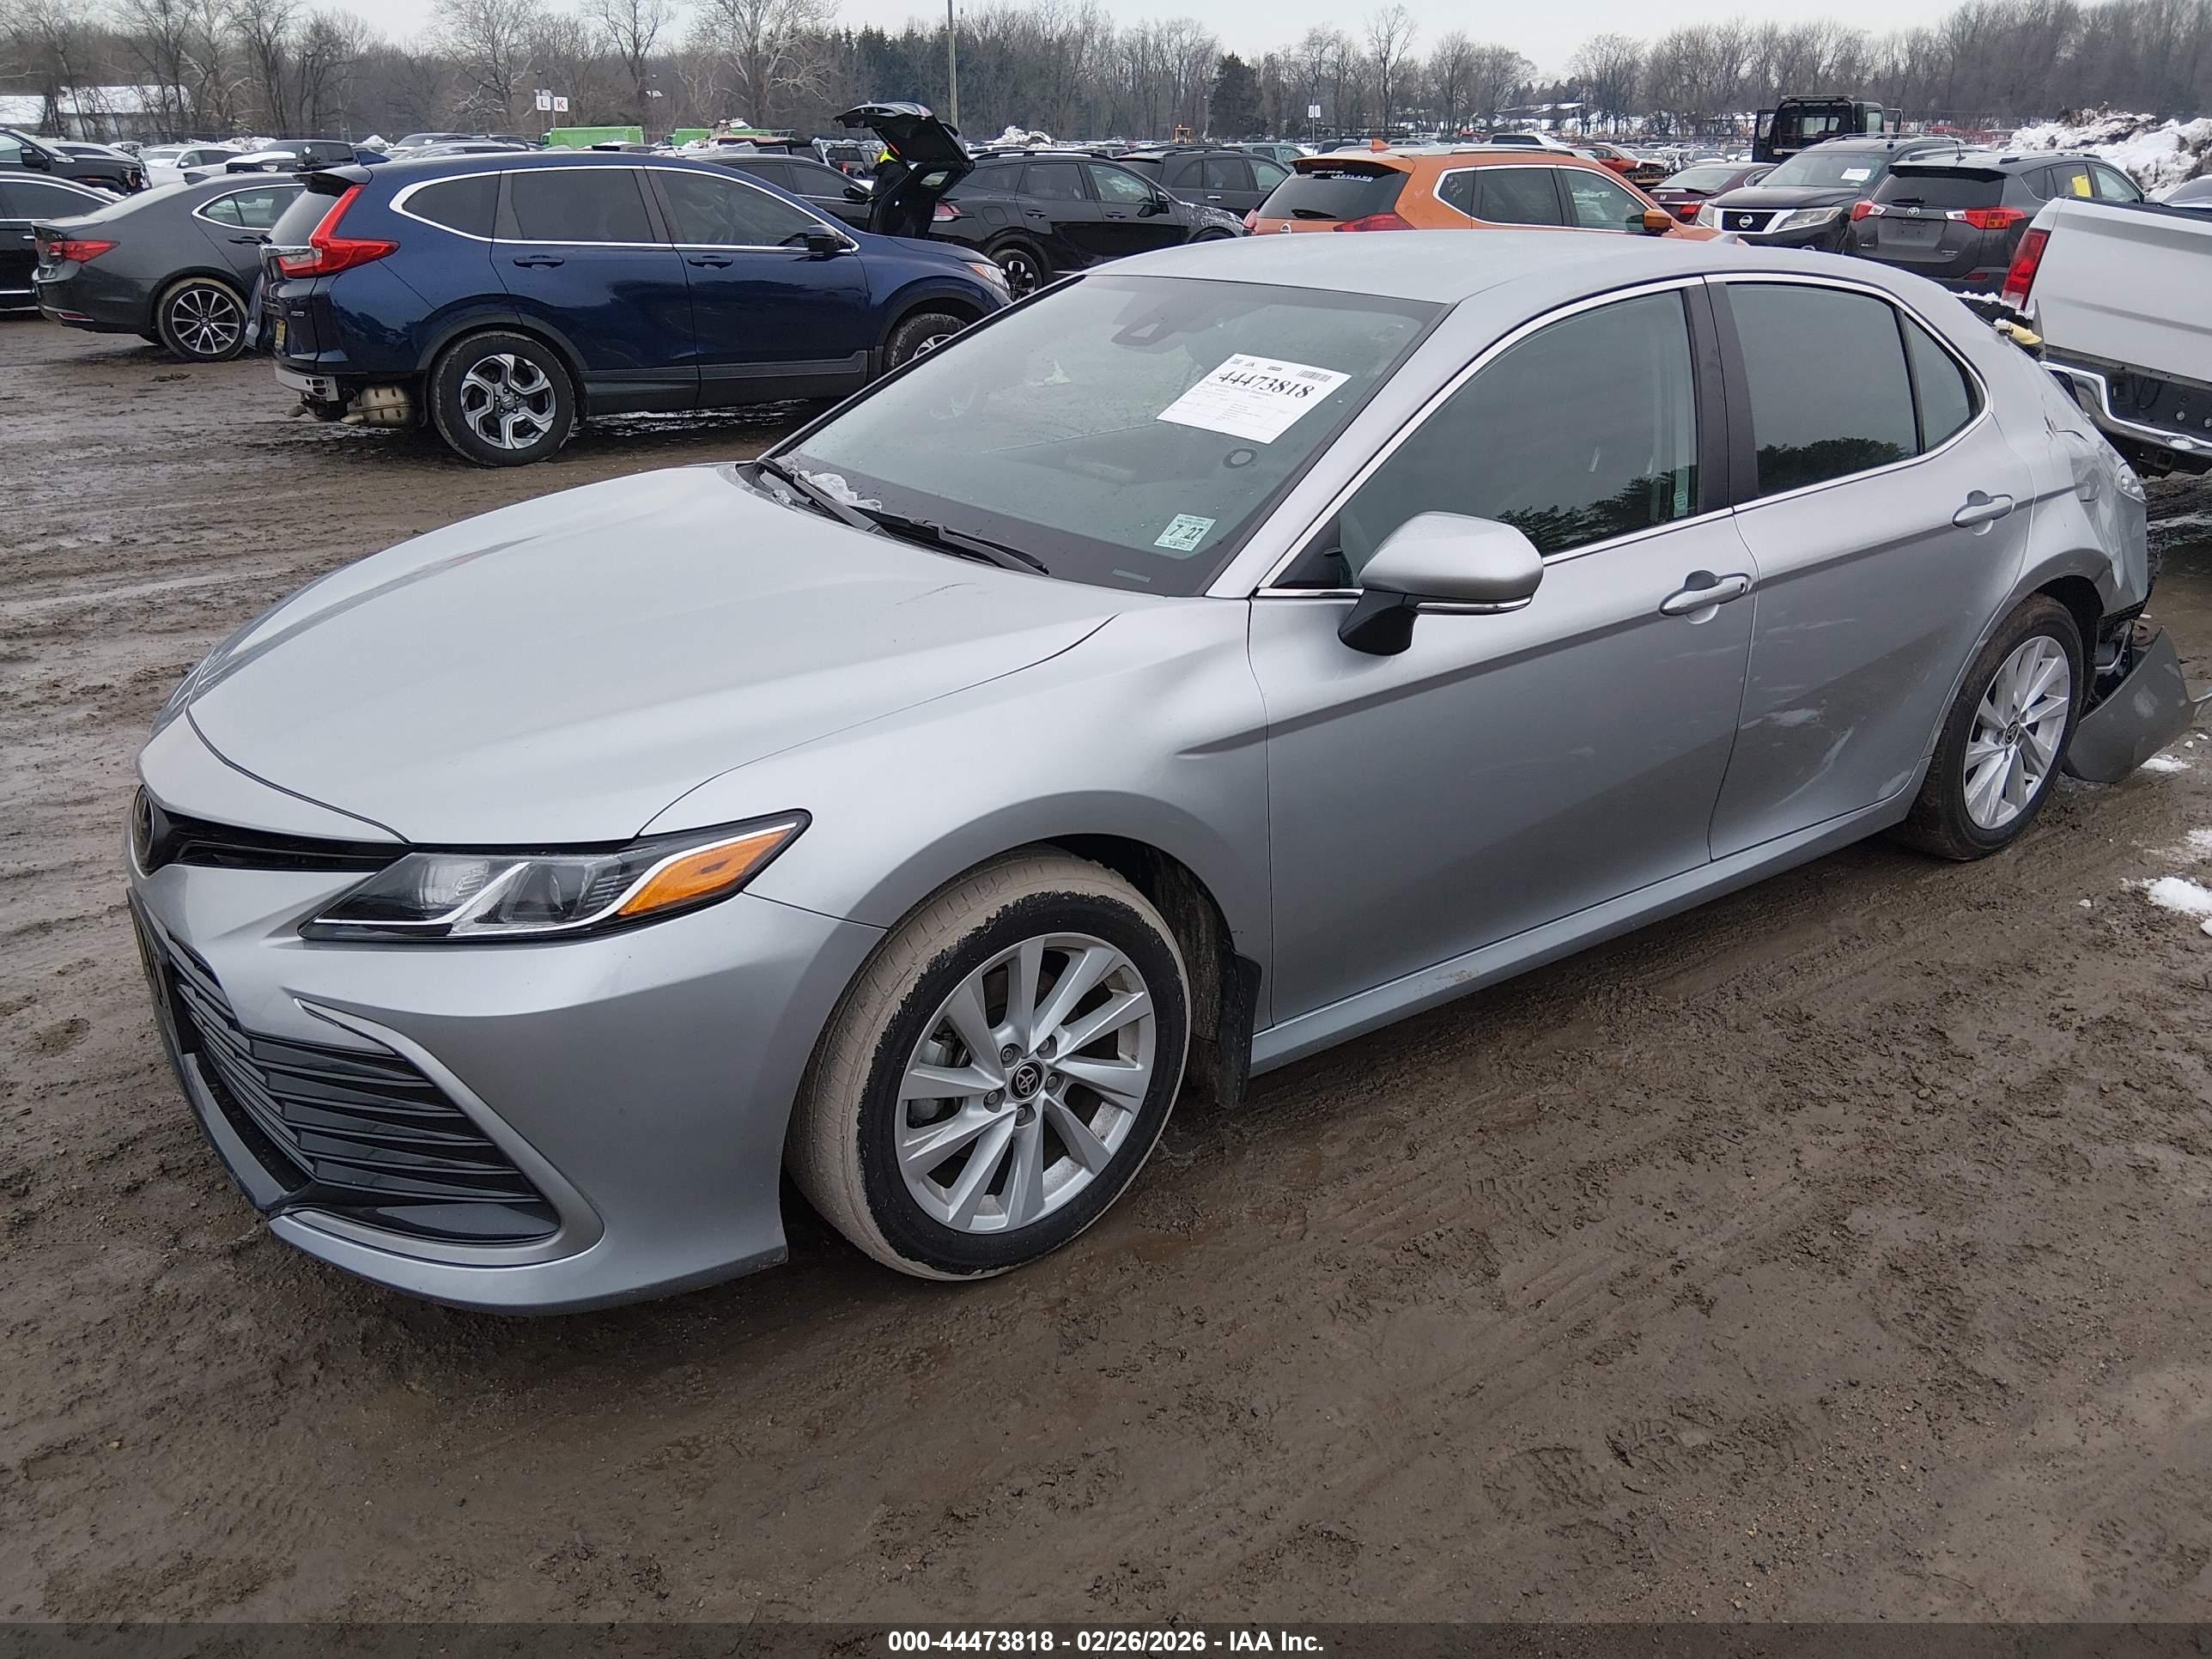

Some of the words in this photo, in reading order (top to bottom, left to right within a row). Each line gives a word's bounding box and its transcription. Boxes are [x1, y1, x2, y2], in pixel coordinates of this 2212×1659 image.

[541, 99, 547, 108] L
[557, 100, 564, 109] K
[1218, 370, 1316, 399] 44473818
